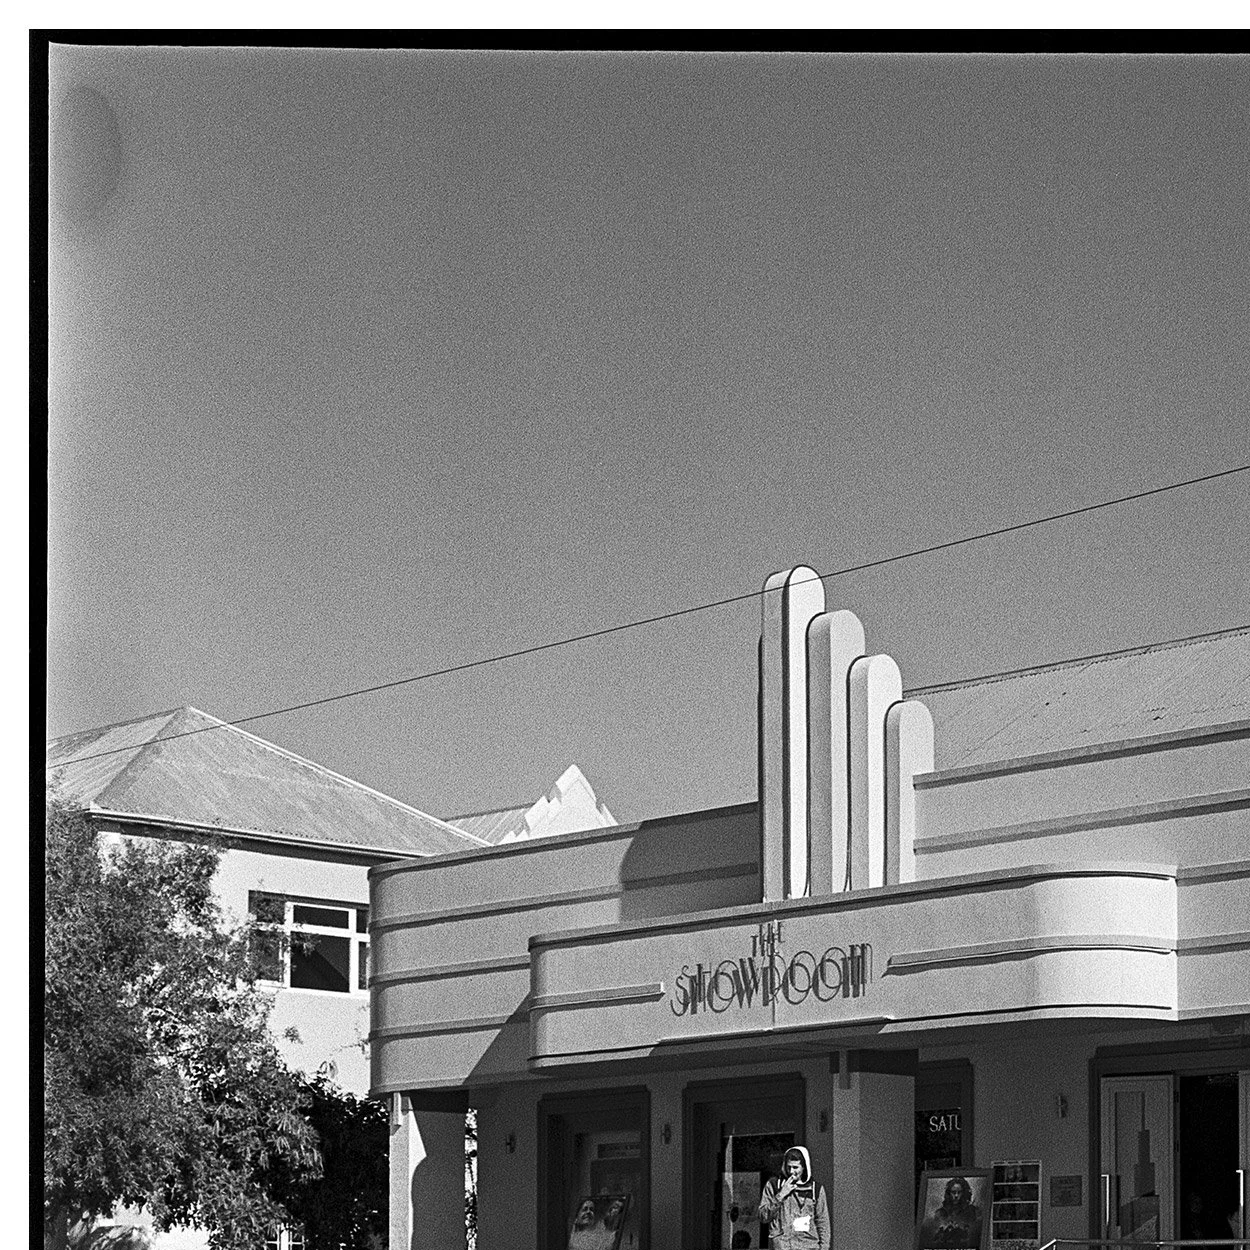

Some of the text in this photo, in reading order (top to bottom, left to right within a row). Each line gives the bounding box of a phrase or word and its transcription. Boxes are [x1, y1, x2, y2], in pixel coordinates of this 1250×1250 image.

[751, 921, 785, 957] THE
[670, 943, 873, 1016] SHOWROOM
[929, 1114, 962, 1132] SATU
